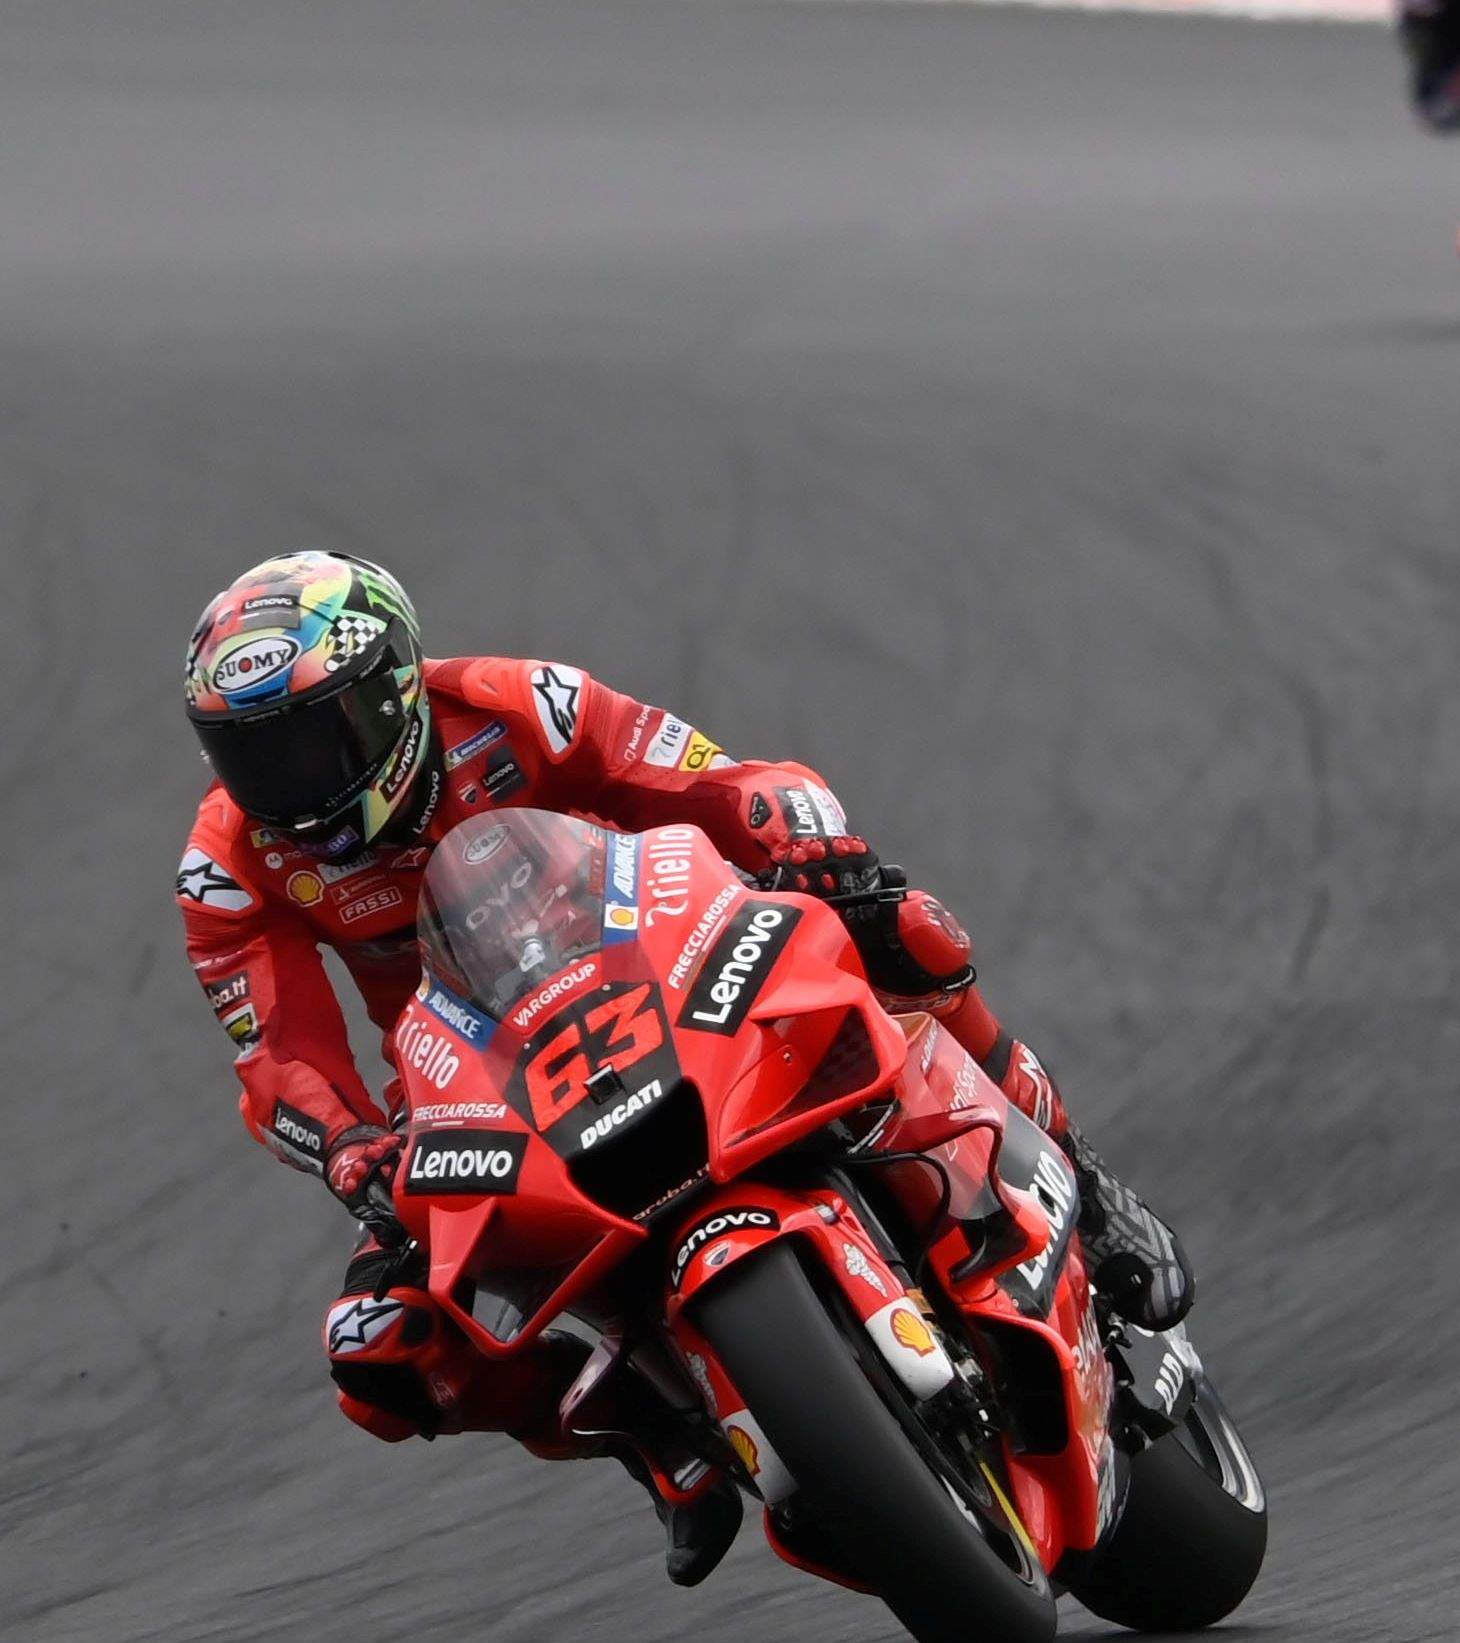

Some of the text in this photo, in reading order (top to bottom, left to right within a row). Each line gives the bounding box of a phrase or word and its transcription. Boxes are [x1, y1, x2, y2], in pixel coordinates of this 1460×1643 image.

[245, 597, 293, 610] Lenovo
[216, 649, 289, 681] SUOMY
[636, 705, 651, 728] Spo
[387, 721, 418, 793] Lenovo
[482, 763, 514, 786] Lenovo
[413, 771, 439, 834] Lenovo
[647, 829, 694, 898] riello
[344, 892, 396, 919] FASSI
[668, 884, 743, 989] FRECCIAROSSA
[512, 963, 597, 1027] VARGROUP
[692, 909, 783, 1024] Lenovo
[429, 990, 481, 1039] ADVANCE
[408, 1021, 460, 1090] riello
[525, 983, 664, 1132] 63
[275, 1107, 321, 1150] Lenovo
[413, 1103, 508, 1121] FRECCIAROSSA
[580, 1079, 663, 1149] DUCATI
[410, 1145, 513, 1179] Lenovo
[632, 1163, 709, 1220] aruba.it
[672, 1211, 772, 1287] Lenovo
[1016, 1151, 1072, 1291] Lovo
